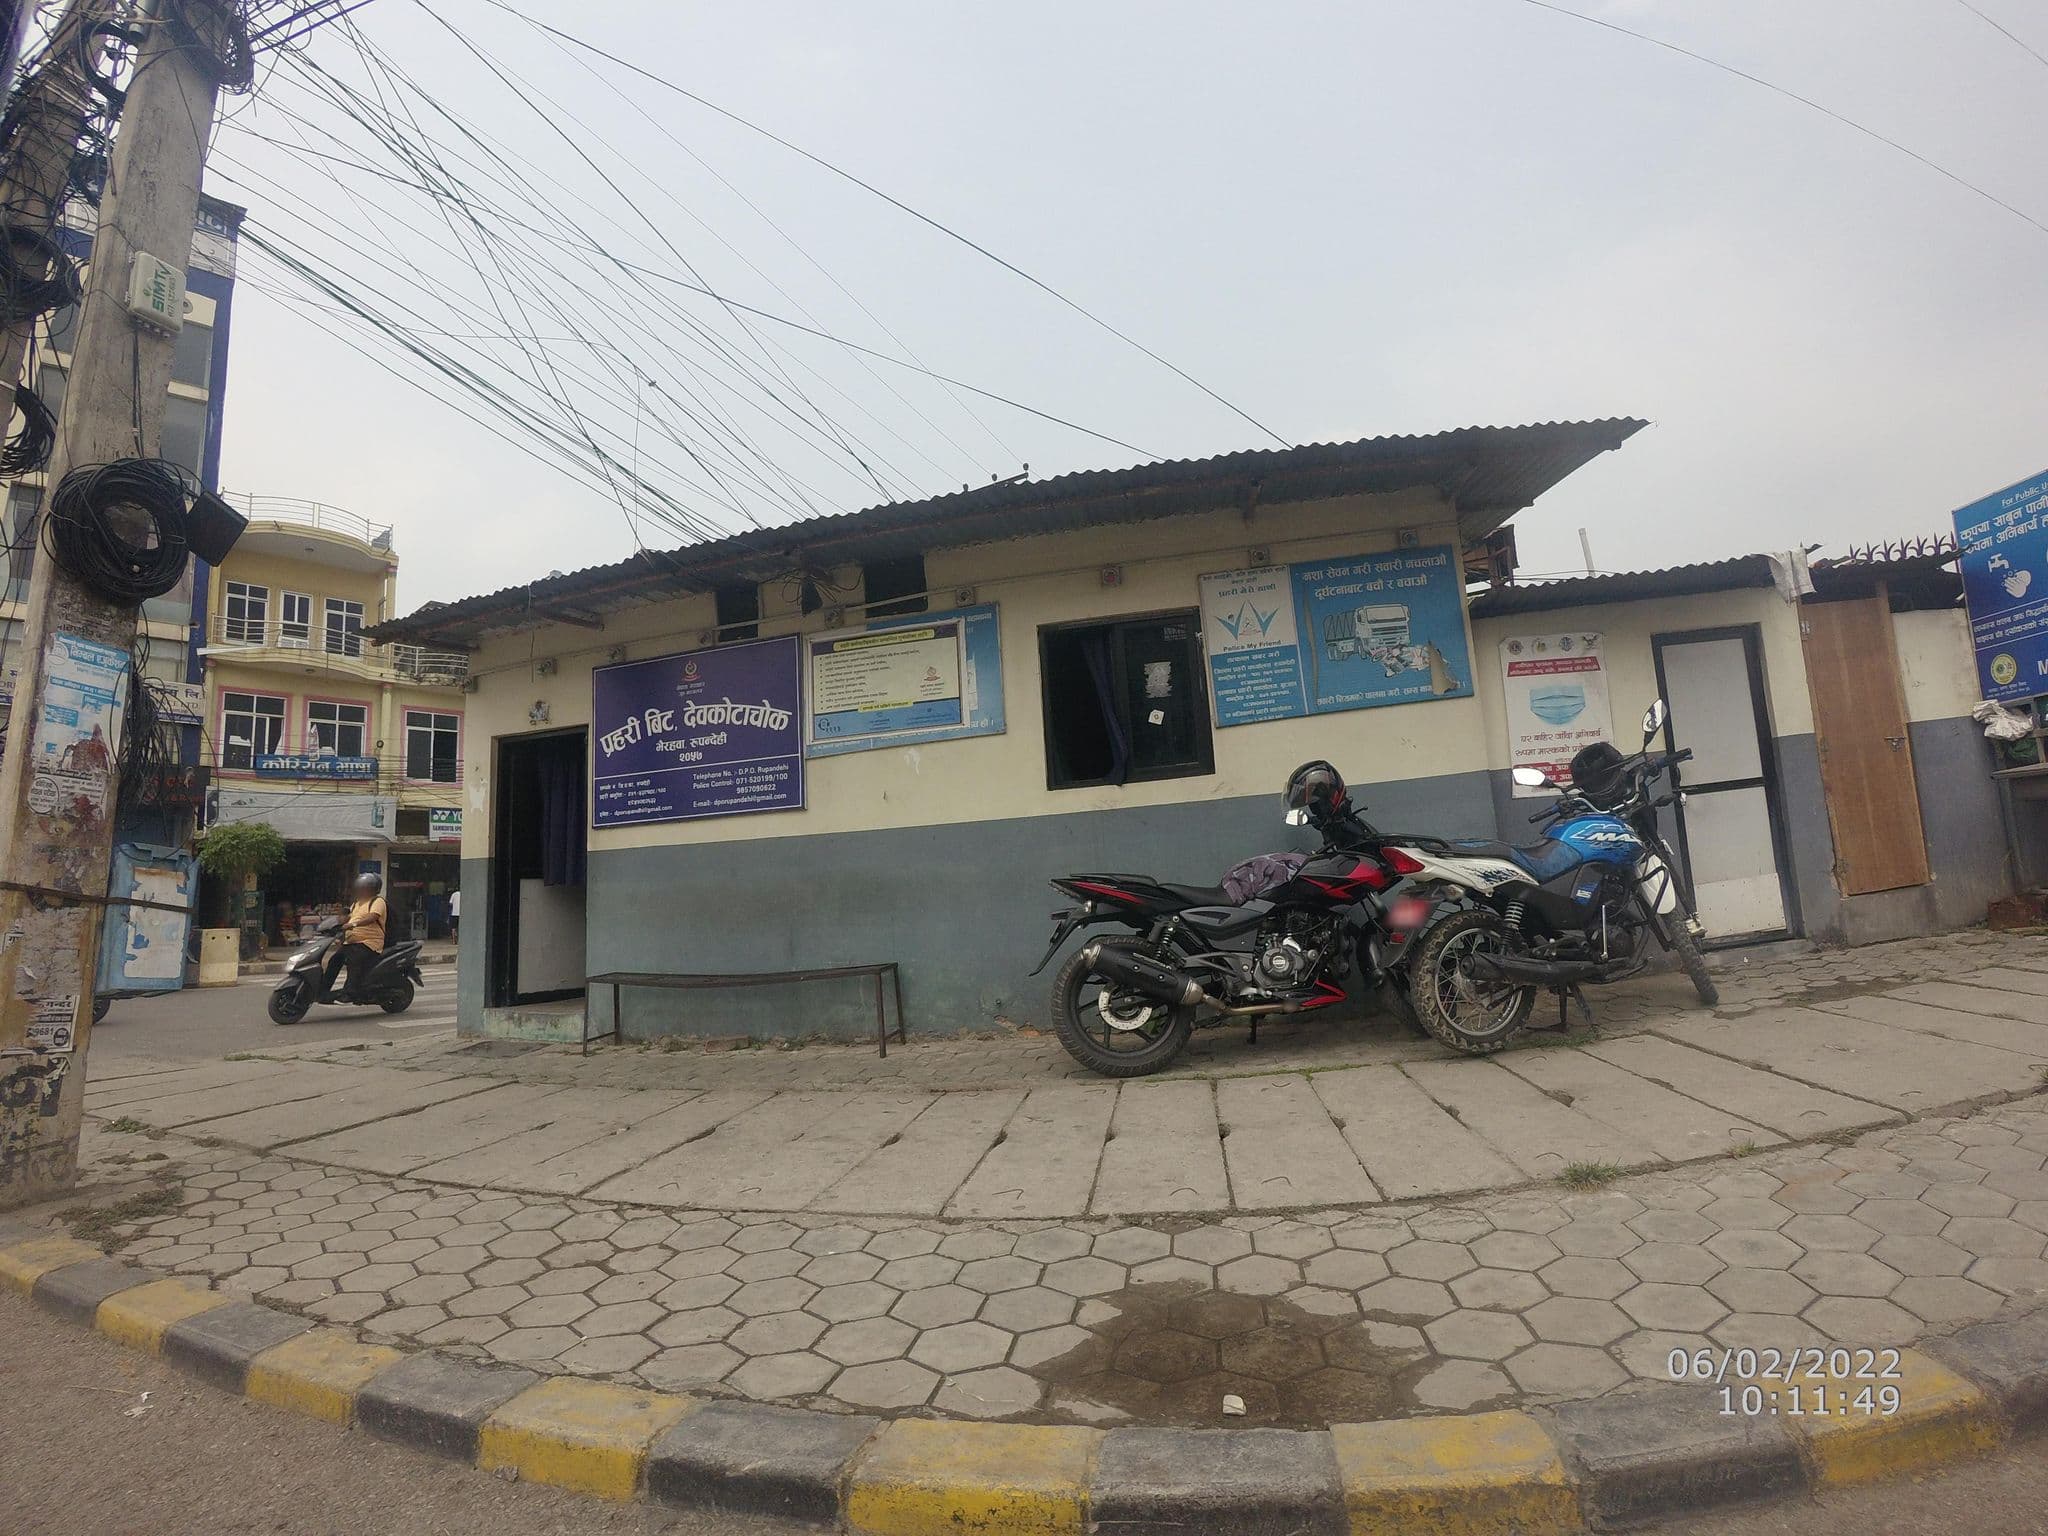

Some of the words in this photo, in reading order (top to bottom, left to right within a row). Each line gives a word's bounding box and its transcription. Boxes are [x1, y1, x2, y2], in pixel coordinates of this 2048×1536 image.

[152, 260, 172, 313] SIMTV
[2002, 498, 2014, 506] For
[2016, 486, 2040, 500] Public
[600, 716, 641, 757] प्रहरी
[683, 697, 792, 731] देवकोटाचोक
[262, 757, 330, 772] कोरियन
[335, 761, 373, 773] भाषा
[693, 772, 721, 781] Telephone
[758, 763, 788, 773] Rupandehi
[693, 781, 709, 789] Police
